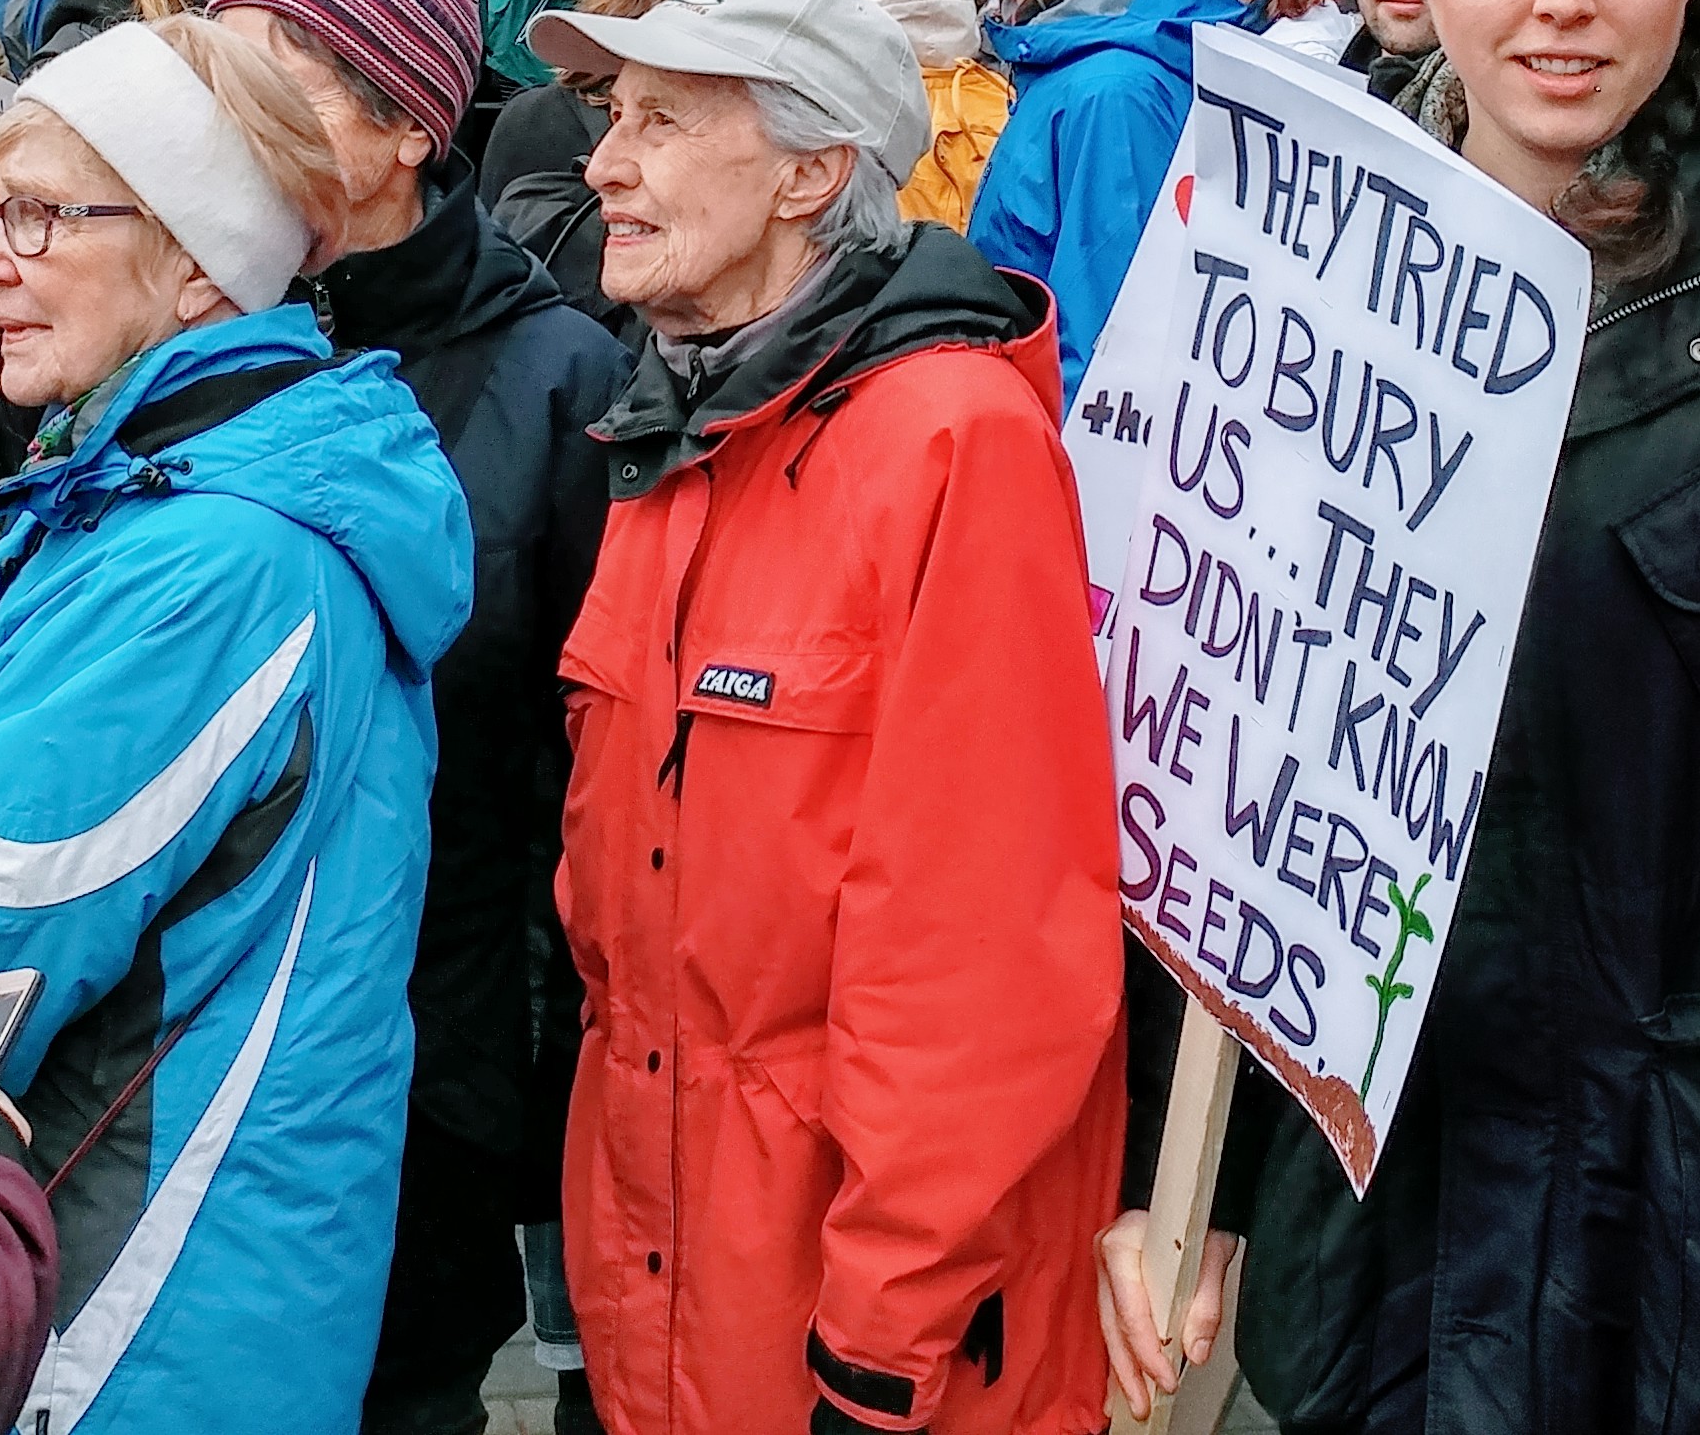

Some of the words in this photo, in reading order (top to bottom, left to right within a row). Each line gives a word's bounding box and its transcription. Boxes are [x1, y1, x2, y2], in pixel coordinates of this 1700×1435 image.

[1196, 83, 1367, 281] THEY
[1365, 171, 1557, 396] TRIED
[1189, 248, 1257, 388] TO
[1262, 306, 1474, 533] BURY
[698, 668, 769, 701] TAIGA
[1139, 512, 1333, 733] DIDN'T
[1327, 658, 1485, 883] KNOW
[1316, 499, 1487, 721] THEY
[1121, 625, 1211, 785] WE
[1223, 713, 1399, 960] WERE
